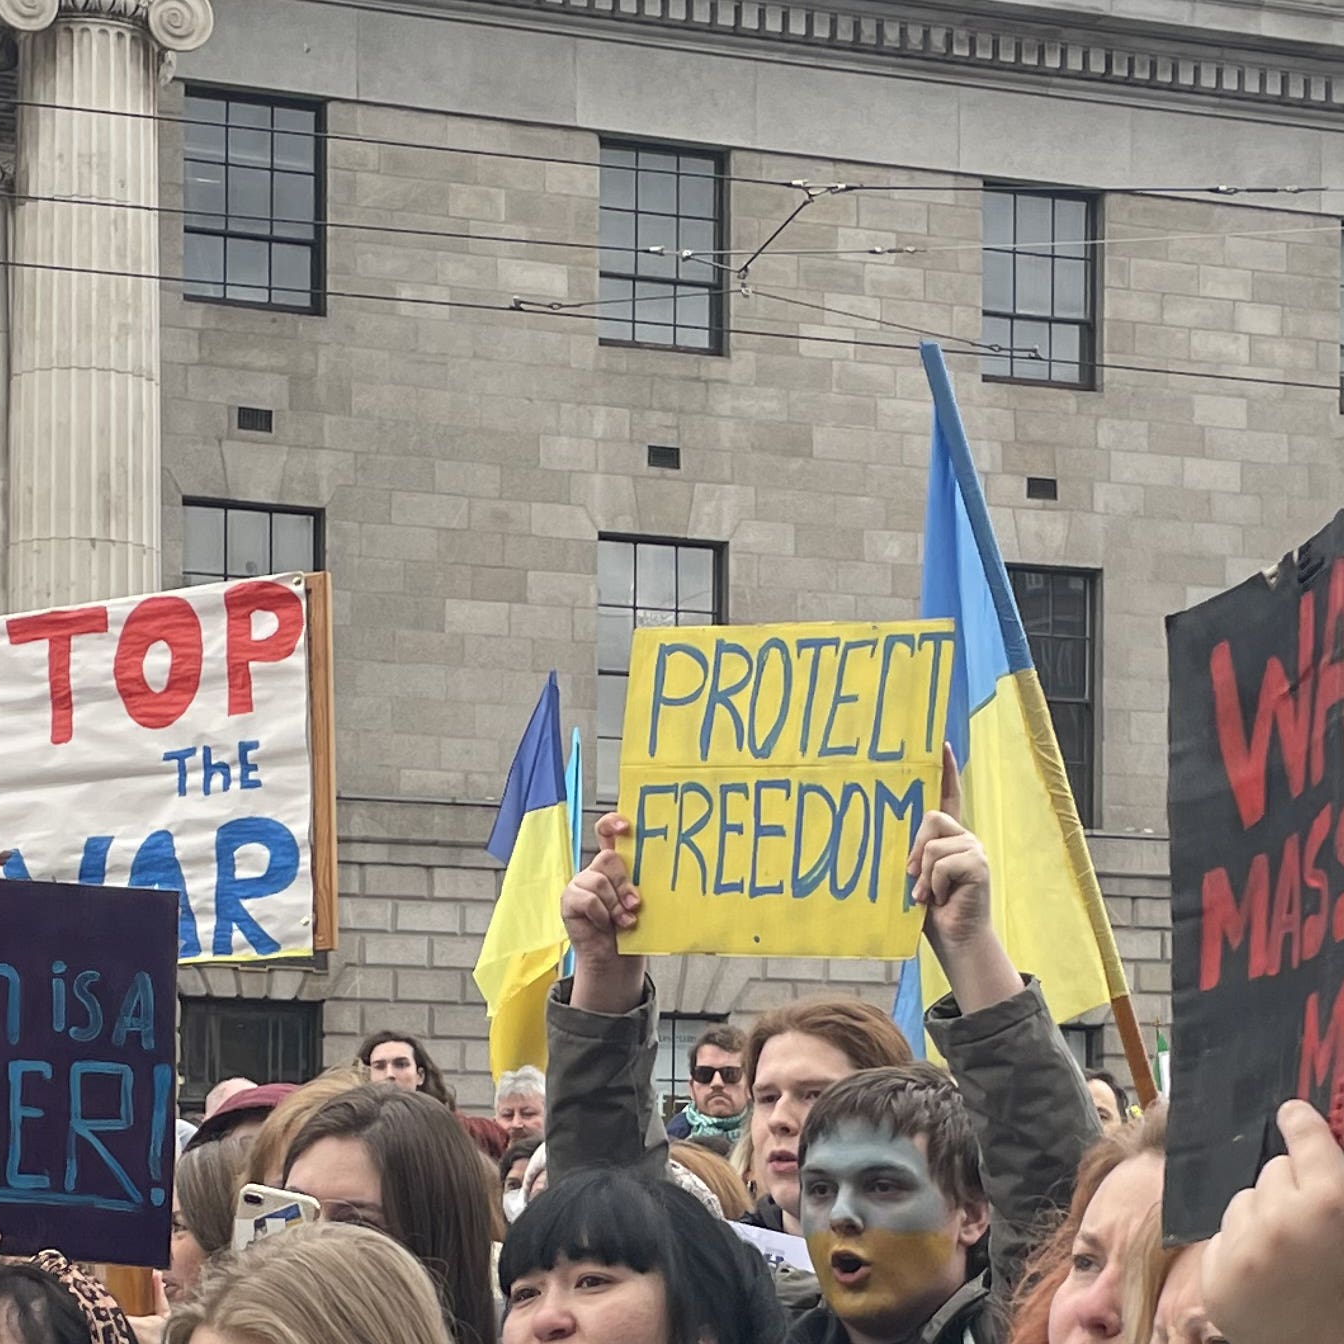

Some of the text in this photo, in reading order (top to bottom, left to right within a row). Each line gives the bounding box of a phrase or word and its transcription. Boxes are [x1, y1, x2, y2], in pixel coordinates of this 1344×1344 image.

[648, 631, 955, 761] PROTECT
[632, 778, 926, 913] FREEDOM
[112, 971, 154, 1049] A
